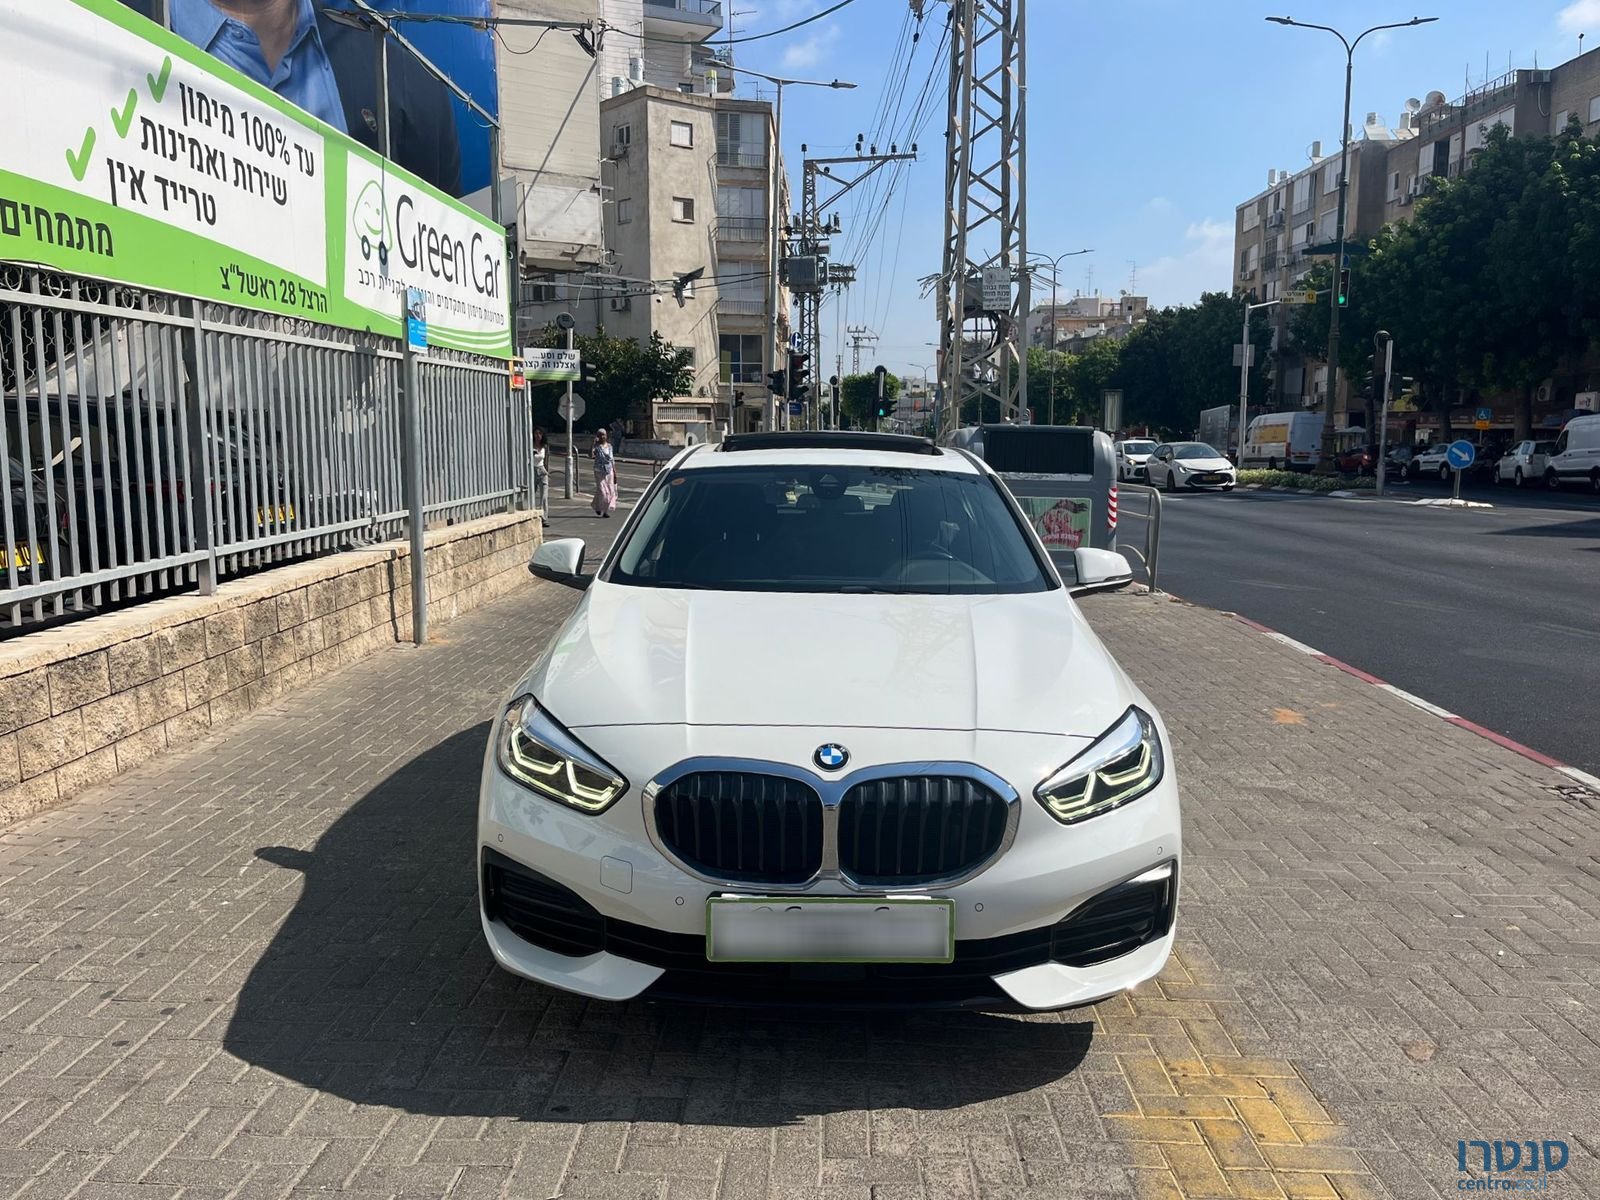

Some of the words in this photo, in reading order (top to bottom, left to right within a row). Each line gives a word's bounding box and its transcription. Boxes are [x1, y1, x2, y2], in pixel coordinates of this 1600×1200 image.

[179, 81, 235, 139] מימון
[139, 115, 228, 182] ואמינות
[240, 111, 291, 166] 100%
[294, 143, 315, 177] עד
[106, 157, 148, 207] אין
[154, 174, 217, 226] טרייד
[232, 157, 288, 206] שירות
[0, 198, 114, 257] מתמחים
[396, 194, 468, 288] Green
[471, 232, 501, 299] Car
[279, 278, 297, 306] 28
[298, 282, 328, 314] הרצל
[358, 268, 376, 288] רכב
[541, 361, 551, 369] זה
[554, 361, 575, 369] אצלנו
[557, 352, 575, 360] שלם
